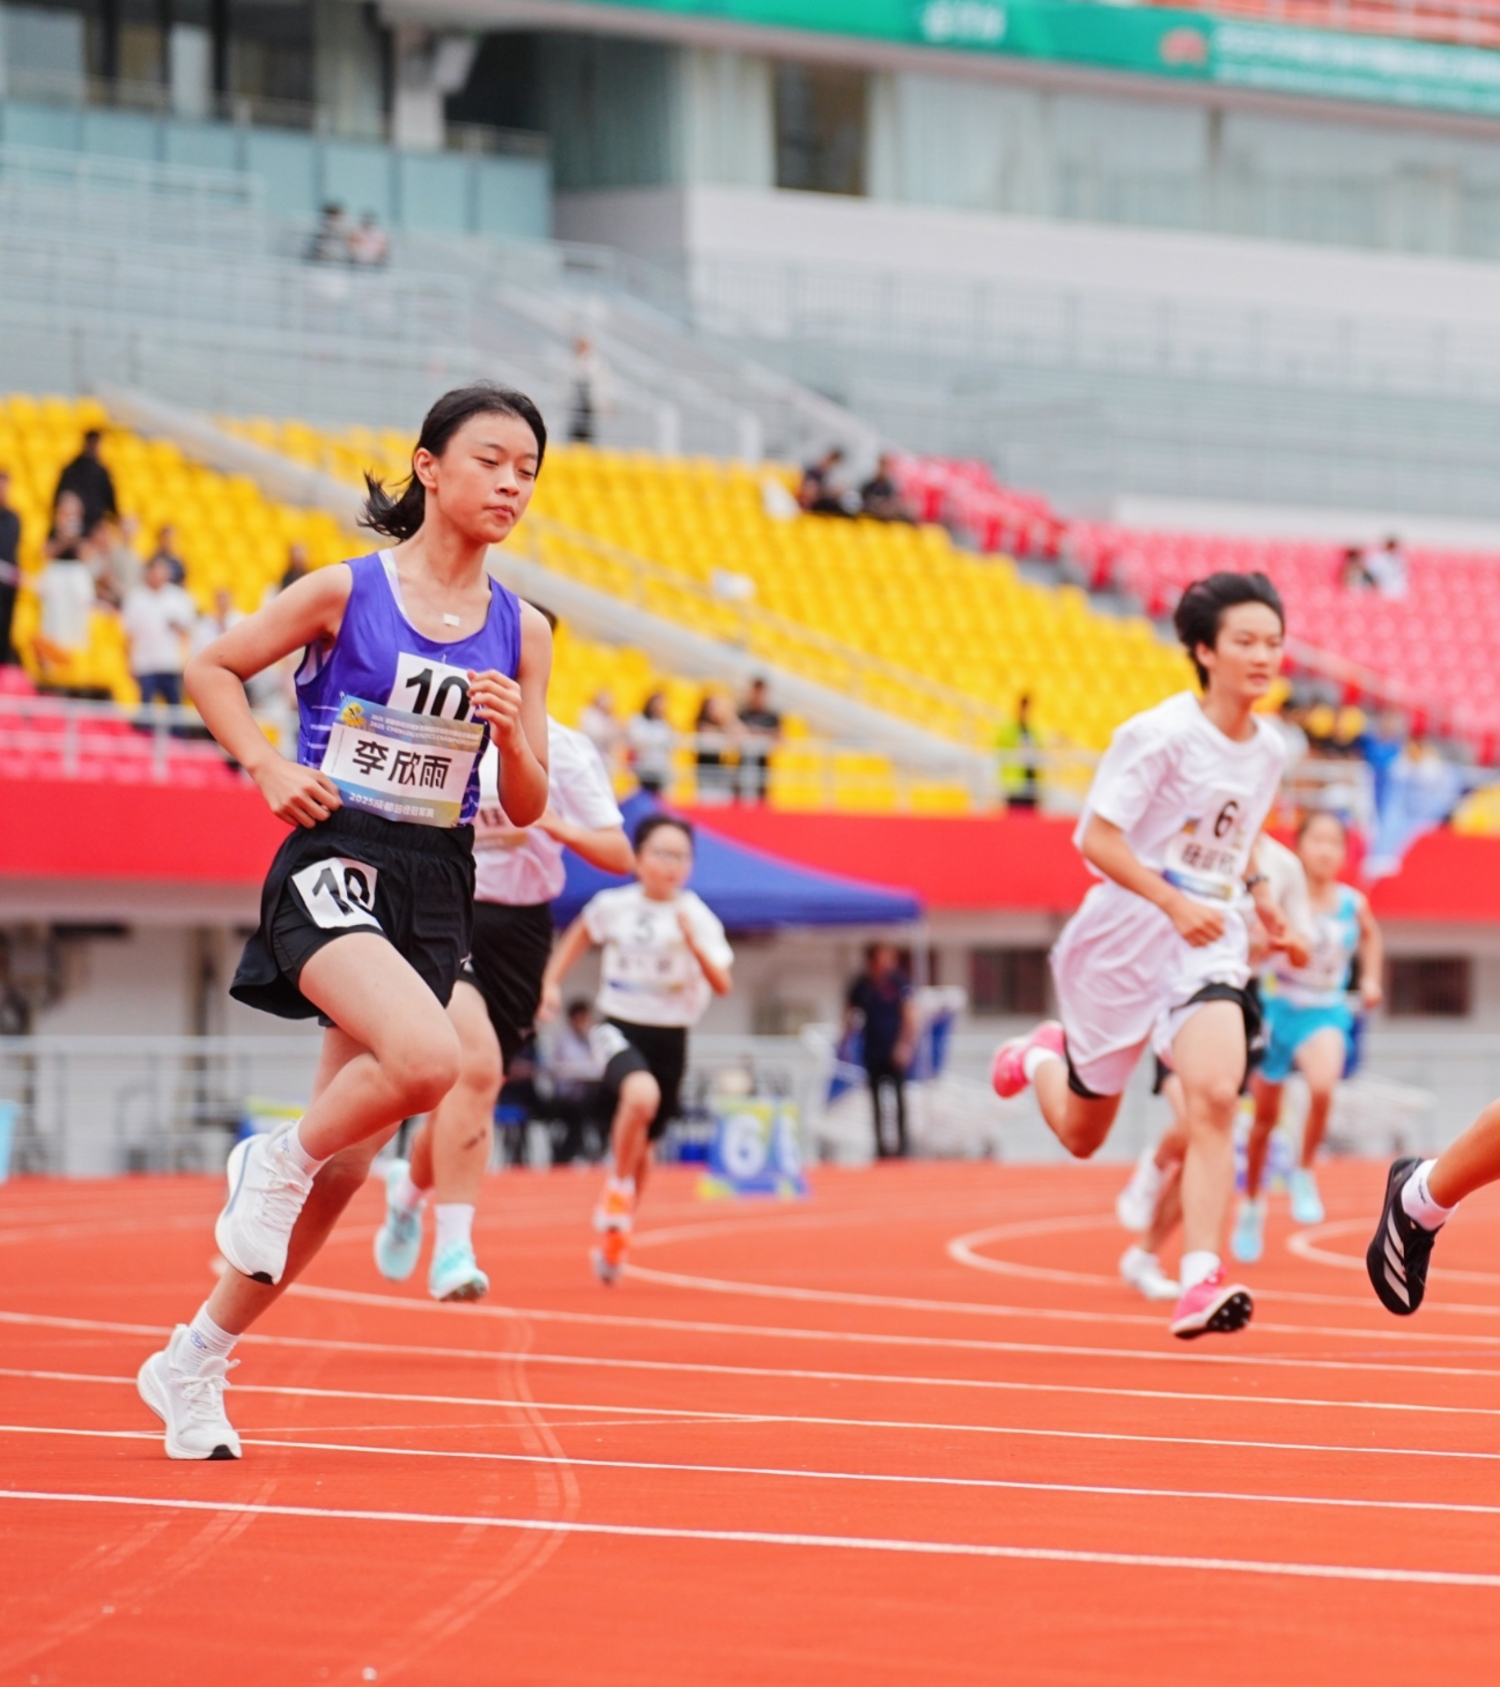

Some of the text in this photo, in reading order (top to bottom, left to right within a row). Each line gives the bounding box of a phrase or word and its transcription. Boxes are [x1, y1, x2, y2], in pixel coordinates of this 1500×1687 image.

[405, 668, 471, 723] 10
[352, 740, 452, 790] 李欣雨
[1213, 799, 1239, 839] 6
[312, 867, 370, 917] 10
[721, 1112, 765, 1179] 6
